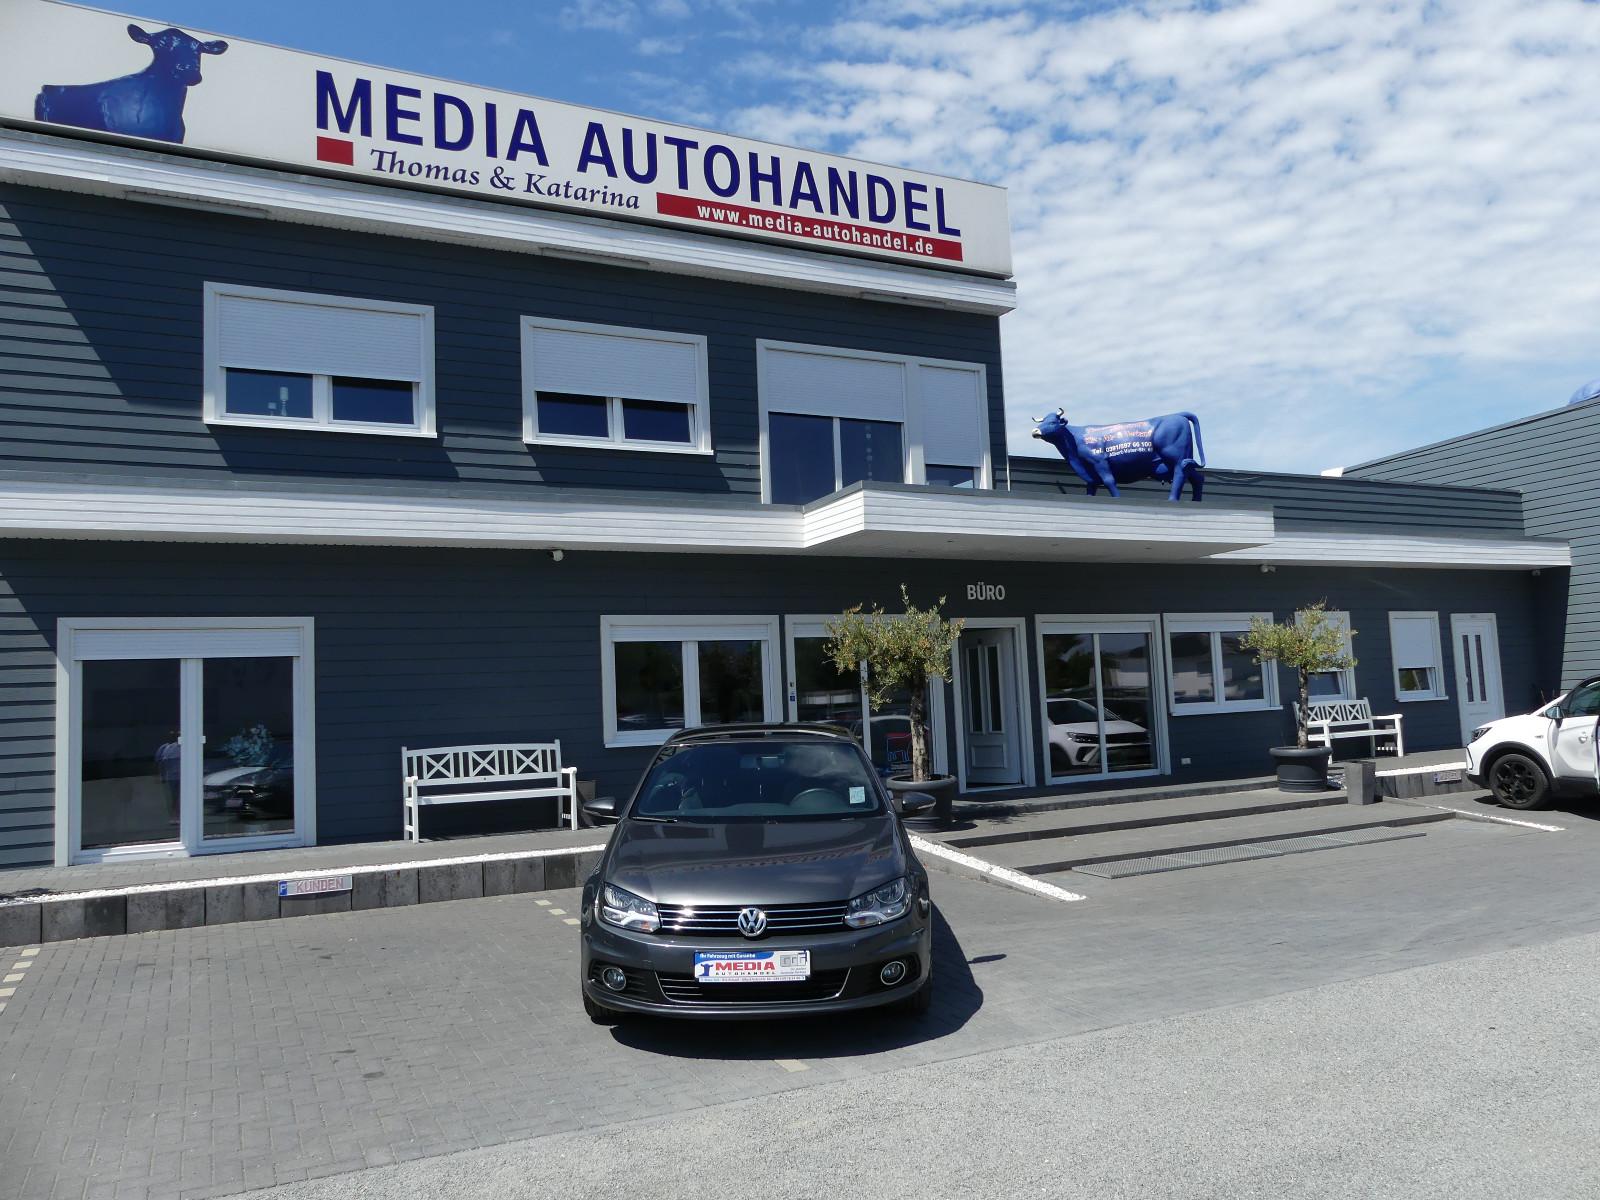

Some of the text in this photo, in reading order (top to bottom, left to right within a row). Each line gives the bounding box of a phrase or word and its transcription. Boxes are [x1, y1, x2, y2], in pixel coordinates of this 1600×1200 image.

[316, 69, 961, 237] MEDIA AUTOHANDEL
[371, 148, 640, 209] Thomas & Katarina
[697, 203, 934, 256] www.media-autohandel.de
[967, 581, 1005, 600] BÜRO
[296, 877, 344, 893] KUNDEN
[715, 961, 776, 971] MEDIA
